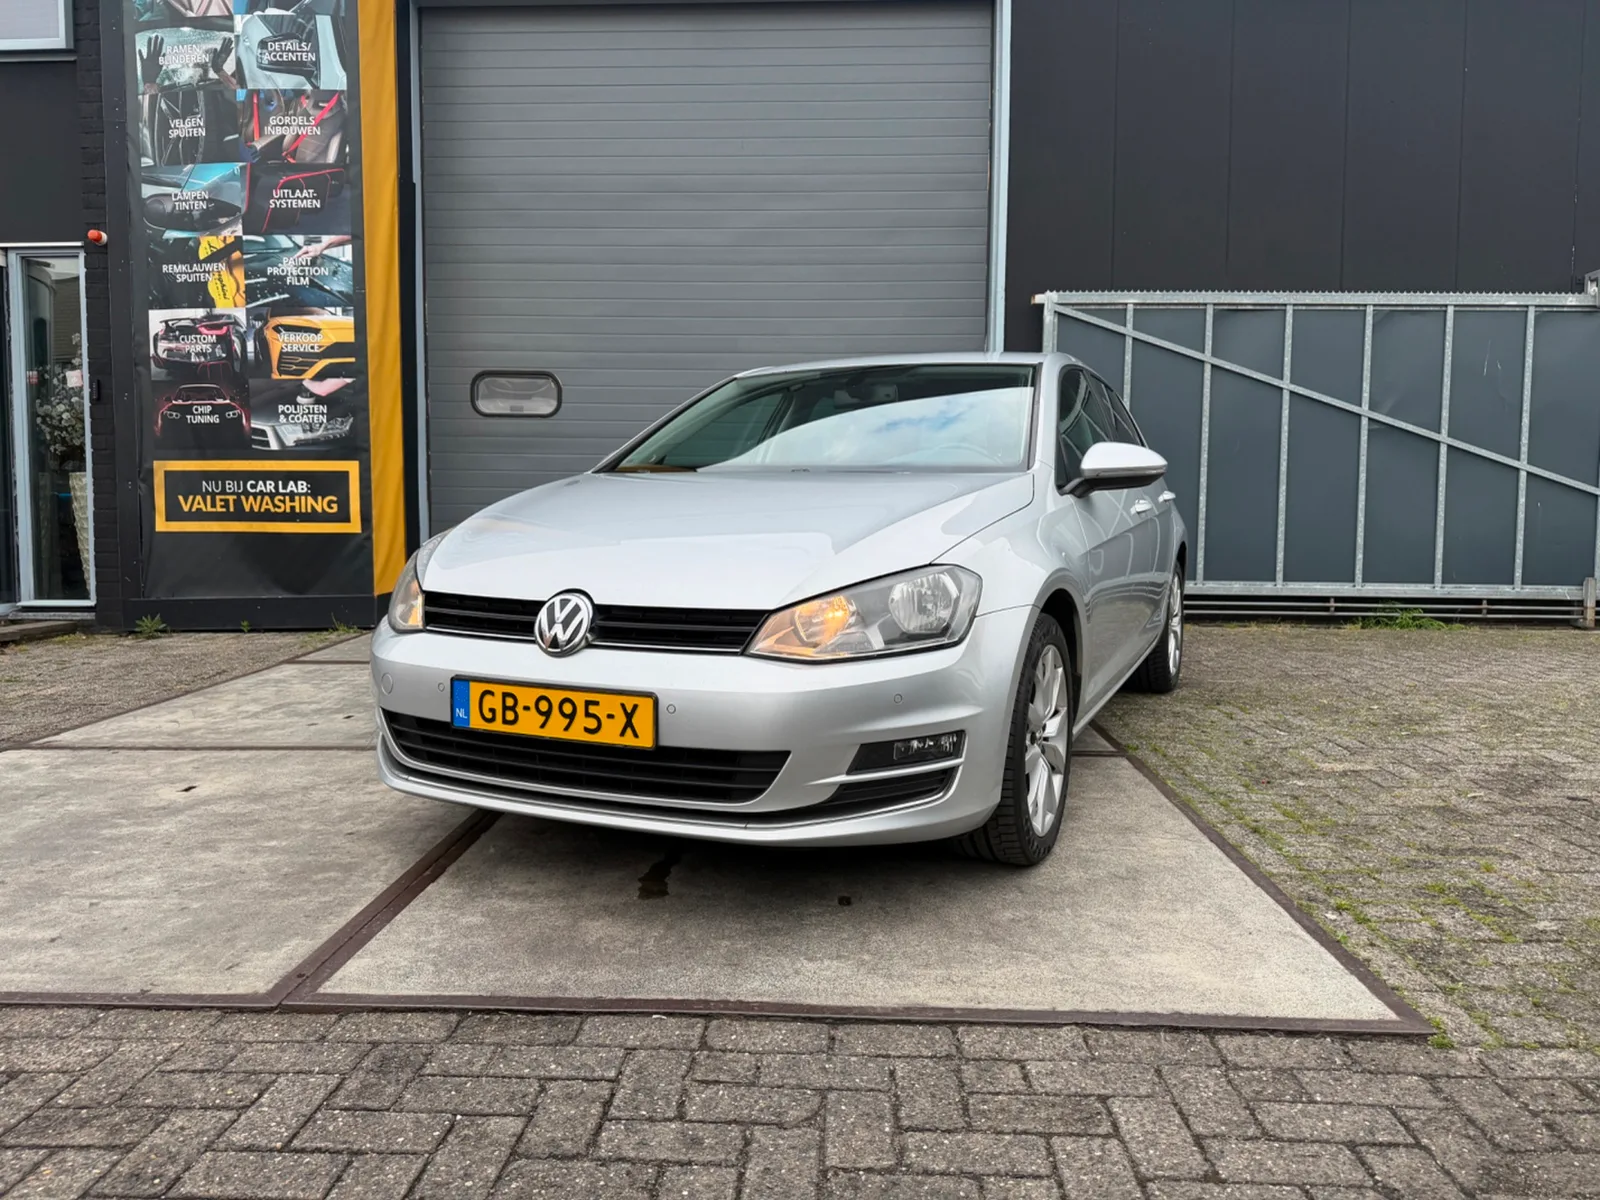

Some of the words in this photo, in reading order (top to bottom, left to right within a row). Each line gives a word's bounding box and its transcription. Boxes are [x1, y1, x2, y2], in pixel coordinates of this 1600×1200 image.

[267, 41, 312, 51] DETAILS/
[158, 53, 210, 66] BLINDEREN
[263, 52, 316, 62] ACCENTEN
[169, 117, 204, 129] VELGEN
[269, 116, 315, 126] GORDELS
[168, 127, 206, 139] SPUITEN
[264, 126, 321, 136] INBOUWEN
[171, 190, 209, 201] LAMPEN
[273, 188, 317, 199] UITLAAT-
[174, 201, 207, 211] TINTEN
[269, 198, 321, 209] SYSTEMEN
[282, 256, 312, 267] PAINT
[162, 262, 226, 274] REMKLAUWEN
[267, 266, 329, 276] PROTECTION
[176, 272, 213, 283] SPUITEN
[286, 276, 310, 286] FILM
[179, 334, 217, 344] CUSTOM
[278, 333, 324, 343] VERKOOP
[185, 343, 212, 353] PARTS
[281, 343, 320, 352] SERVICE
[192, 405, 212, 415] CHIP
[278, 404, 327, 416] POLIJSTEN
[186, 415, 220, 424] TUNING
[279, 414, 289, 424] &
[291, 414, 327, 424] COATEN
[202, 481, 222, 493] NU
[225, 481, 244, 493] BIJ
[246, 480, 276, 493] CAR
[278, 481, 311, 494] LAB:
[178, 495, 237, 512] VALET
[241, 496, 338, 513] WASHING
[455, 708, 467, 719] NL
[478, 689, 640, 739] GB-995-X
